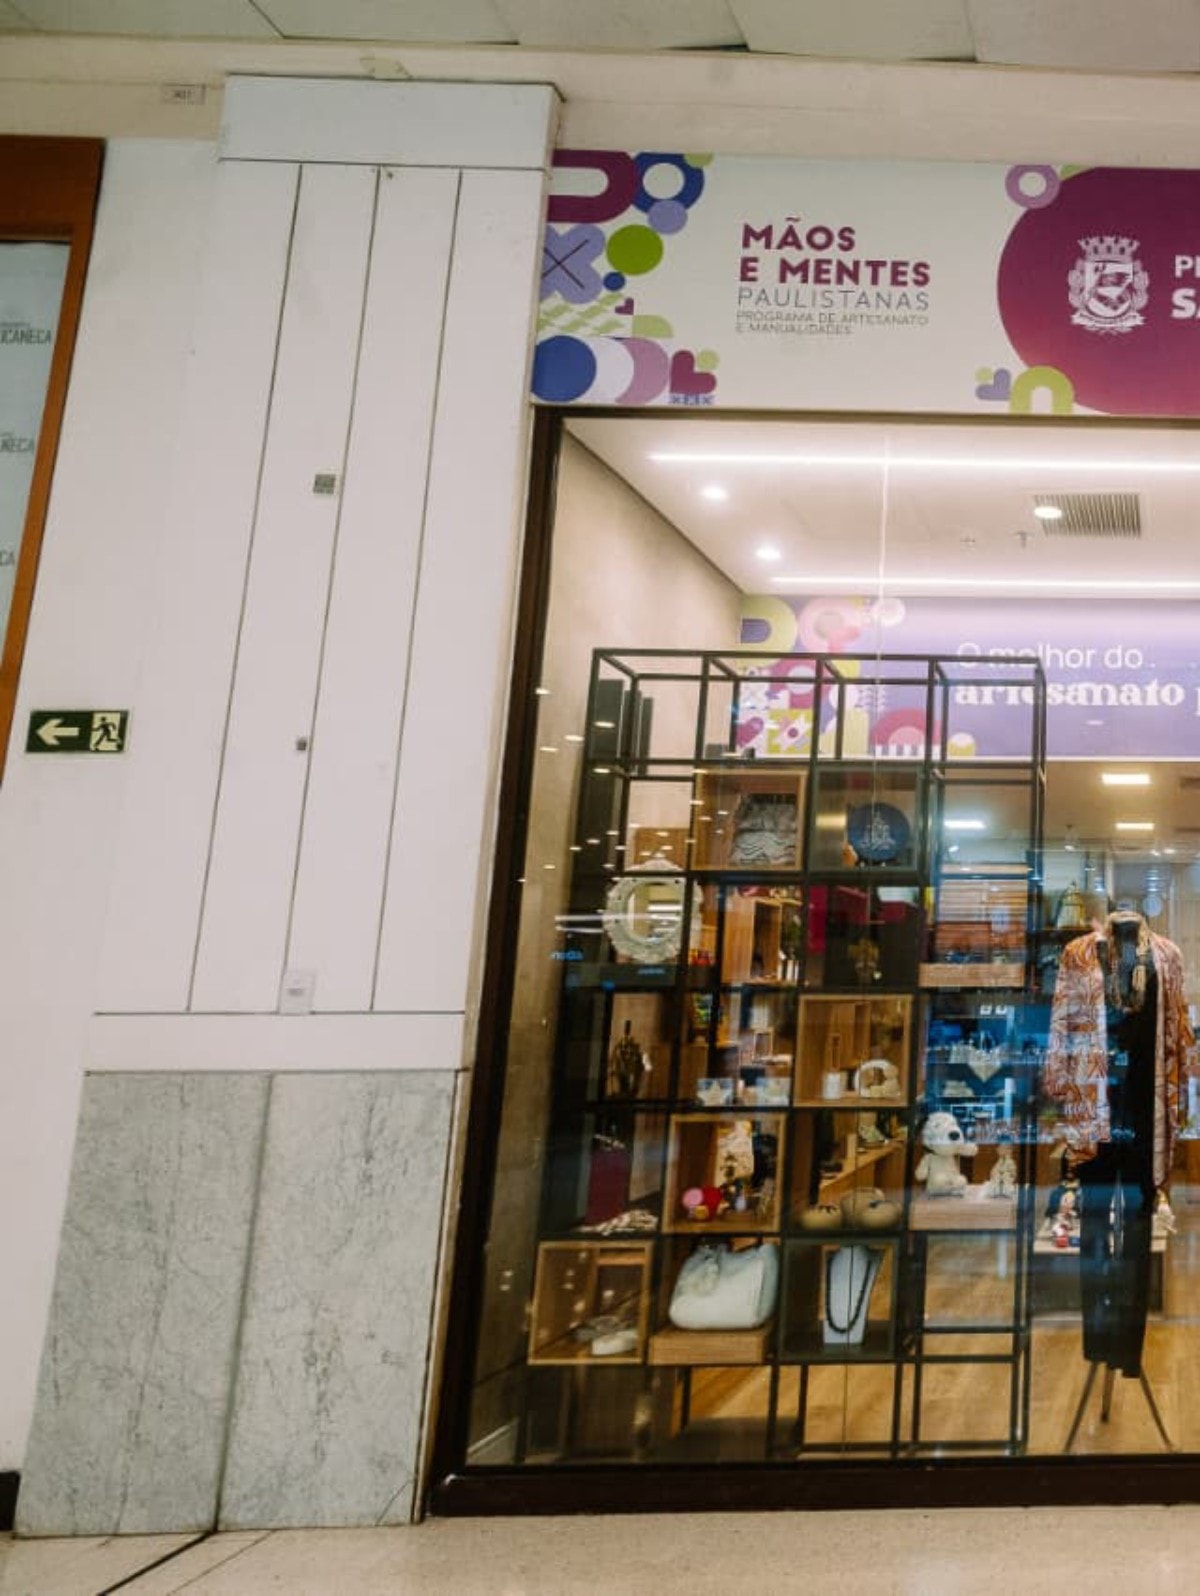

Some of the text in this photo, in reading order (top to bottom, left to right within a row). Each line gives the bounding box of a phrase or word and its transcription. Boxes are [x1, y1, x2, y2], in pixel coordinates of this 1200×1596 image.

[742, 216, 856, 252] MÃOS
[740, 256, 930, 287] E MENTES
[738, 286, 929, 312] PAULISTANAS
[735, 323, 853, 335] E MANUALIDADES
[736, 311, 929, 327] PROGRAMA DE ARTESANATO
[957, 642, 981, 669] O
[1103, 643, 1143, 669] do
